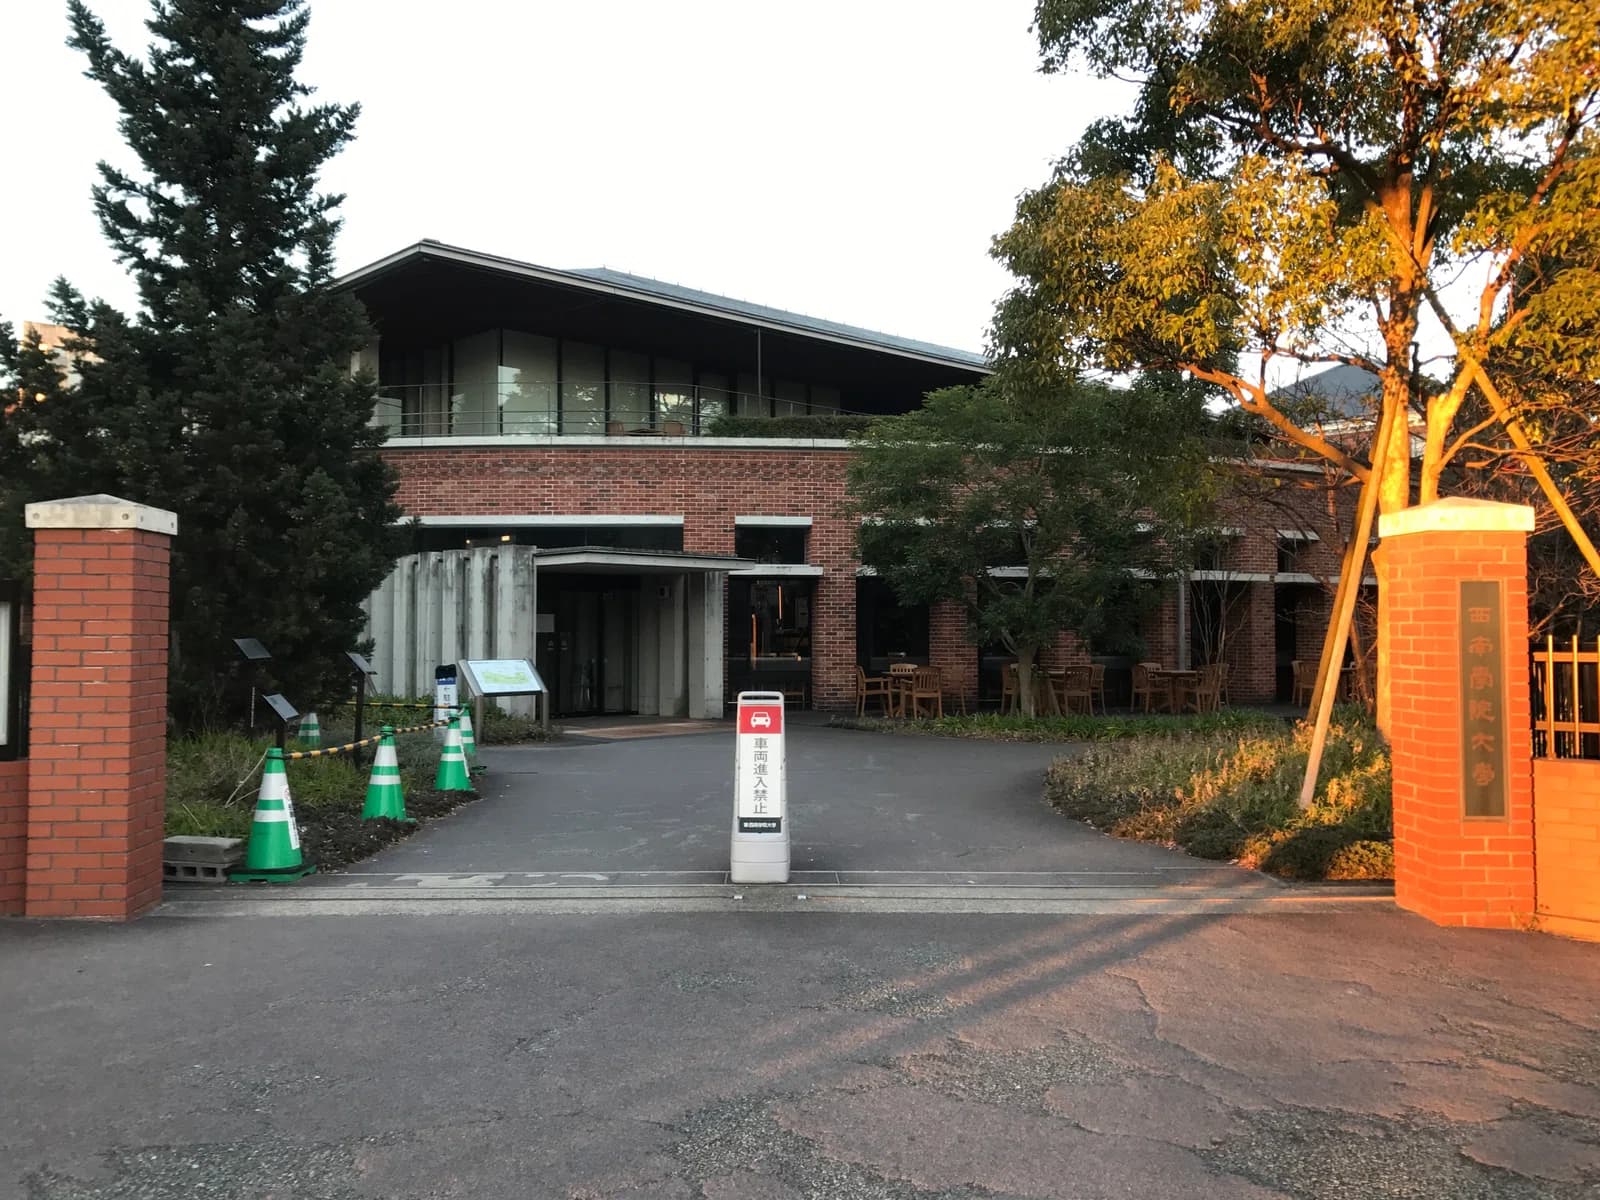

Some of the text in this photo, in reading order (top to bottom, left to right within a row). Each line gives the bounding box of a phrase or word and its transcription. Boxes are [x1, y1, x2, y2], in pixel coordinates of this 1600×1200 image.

[753, 737, 768, 814] 車両進入禁止
